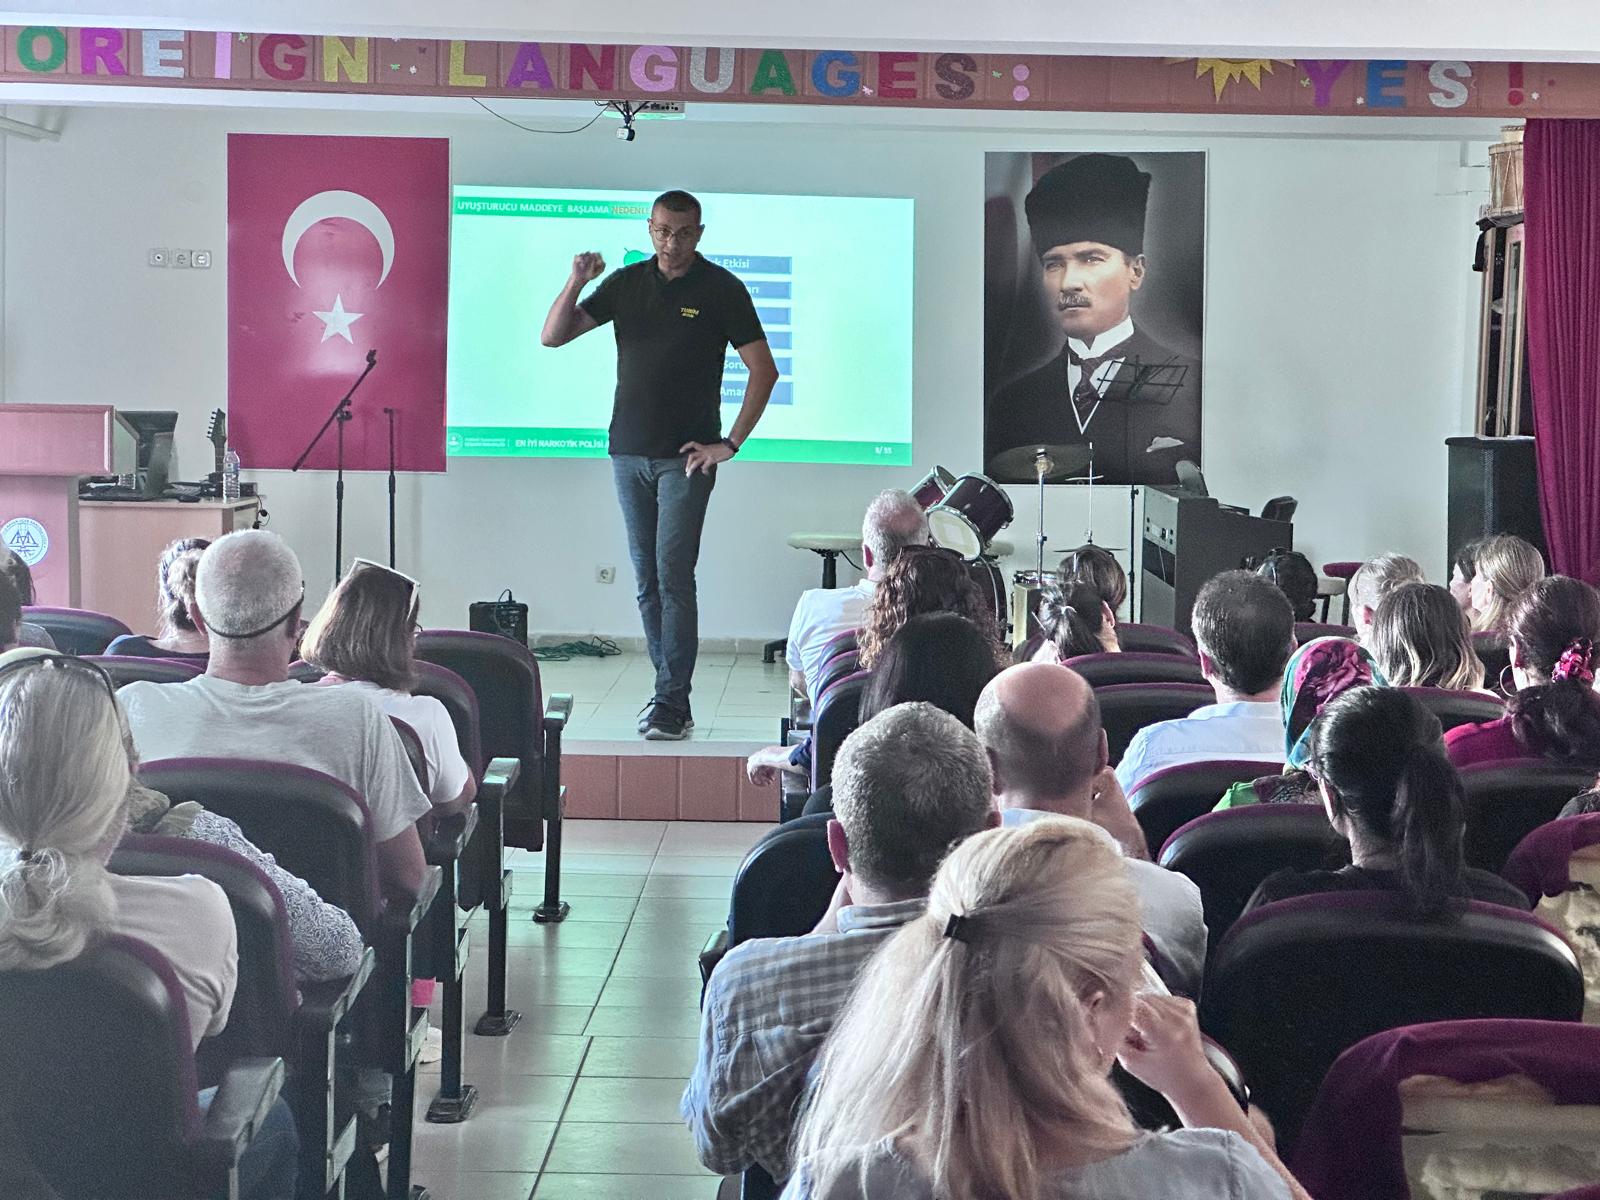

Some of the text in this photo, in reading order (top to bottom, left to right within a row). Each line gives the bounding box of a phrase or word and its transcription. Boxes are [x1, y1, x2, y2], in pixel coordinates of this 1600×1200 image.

[457, 201, 518, 212] UYUŞTURUCU
[519, 203, 563, 213] MADDEYE
[567, 205, 609, 215] BAŞLAMA
[723, 258, 750, 268] Etkisi
[724, 360, 746, 369] Soru
